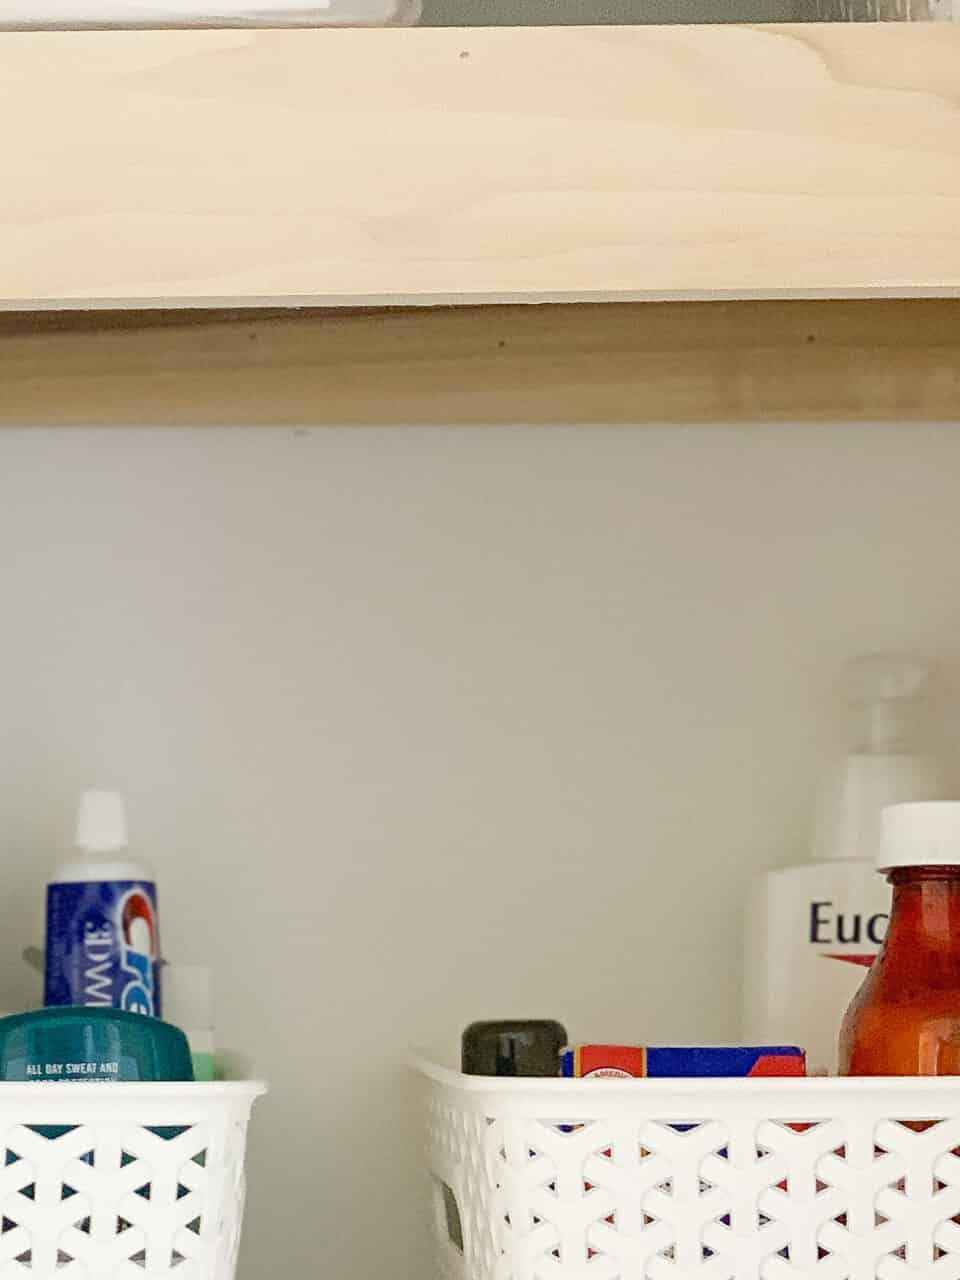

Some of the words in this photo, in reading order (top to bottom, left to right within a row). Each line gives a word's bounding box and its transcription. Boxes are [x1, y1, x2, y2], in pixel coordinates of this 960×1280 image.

[26, 1064, 42, 1075] ALL
[45, 1063, 64, 1075] DAY
[65, 1062, 97, 1074] SWEAT
[100, 1061, 119, 1073] AND
